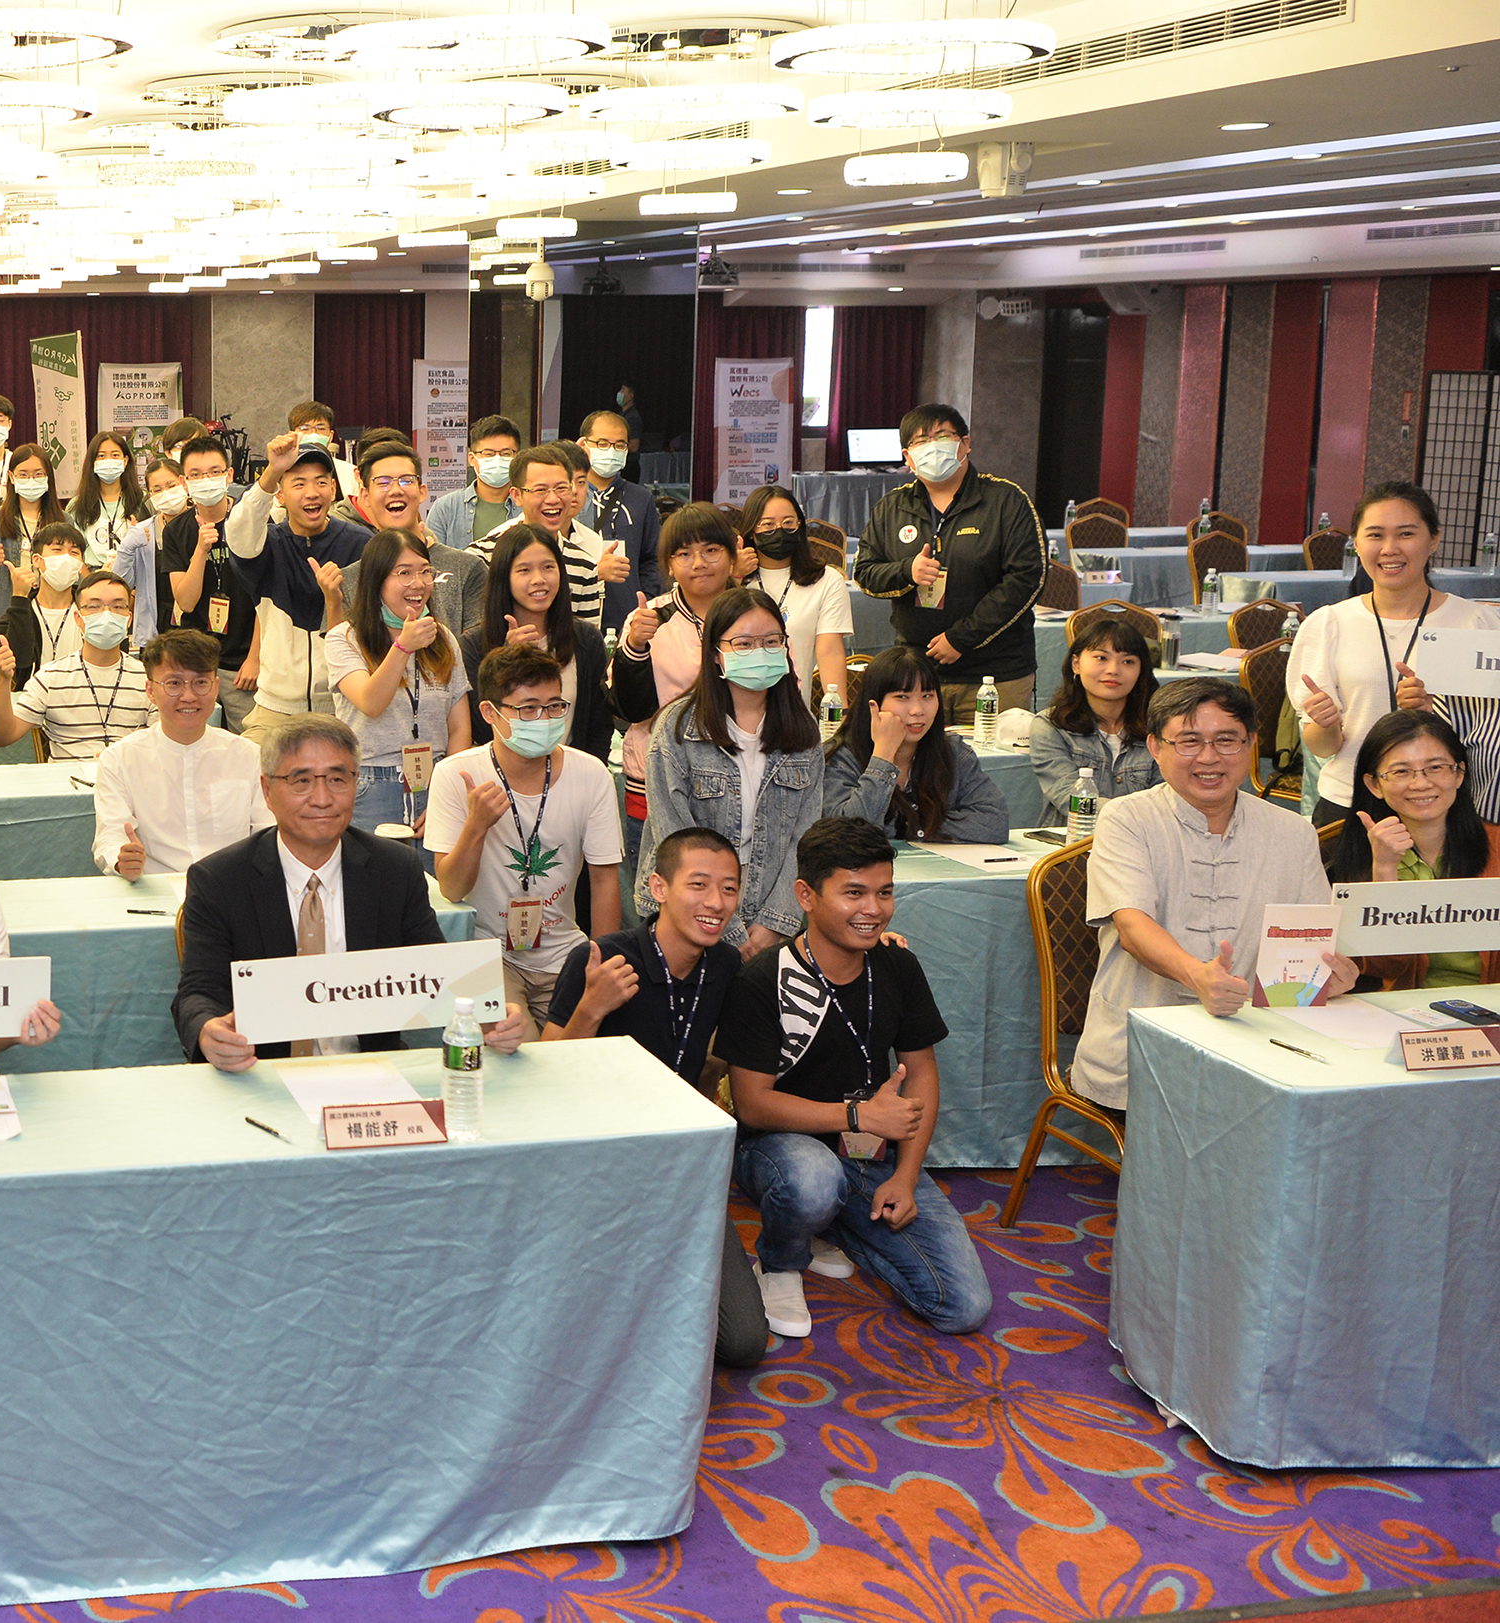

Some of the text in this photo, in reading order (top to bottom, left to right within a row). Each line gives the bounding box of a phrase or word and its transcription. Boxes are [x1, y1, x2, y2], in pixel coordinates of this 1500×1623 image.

[112, 380, 169, 389] 科技股份有限公司
[730, 384, 760, 398] Wecs
[1361, 903, 1500, 927] Breakthrou
[305, 972, 445, 1004] Creativity
[1421, 1045, 1465, 1062] 洪肇嘉
[347, 1120, 424, 1139] 楊能舒 校長
